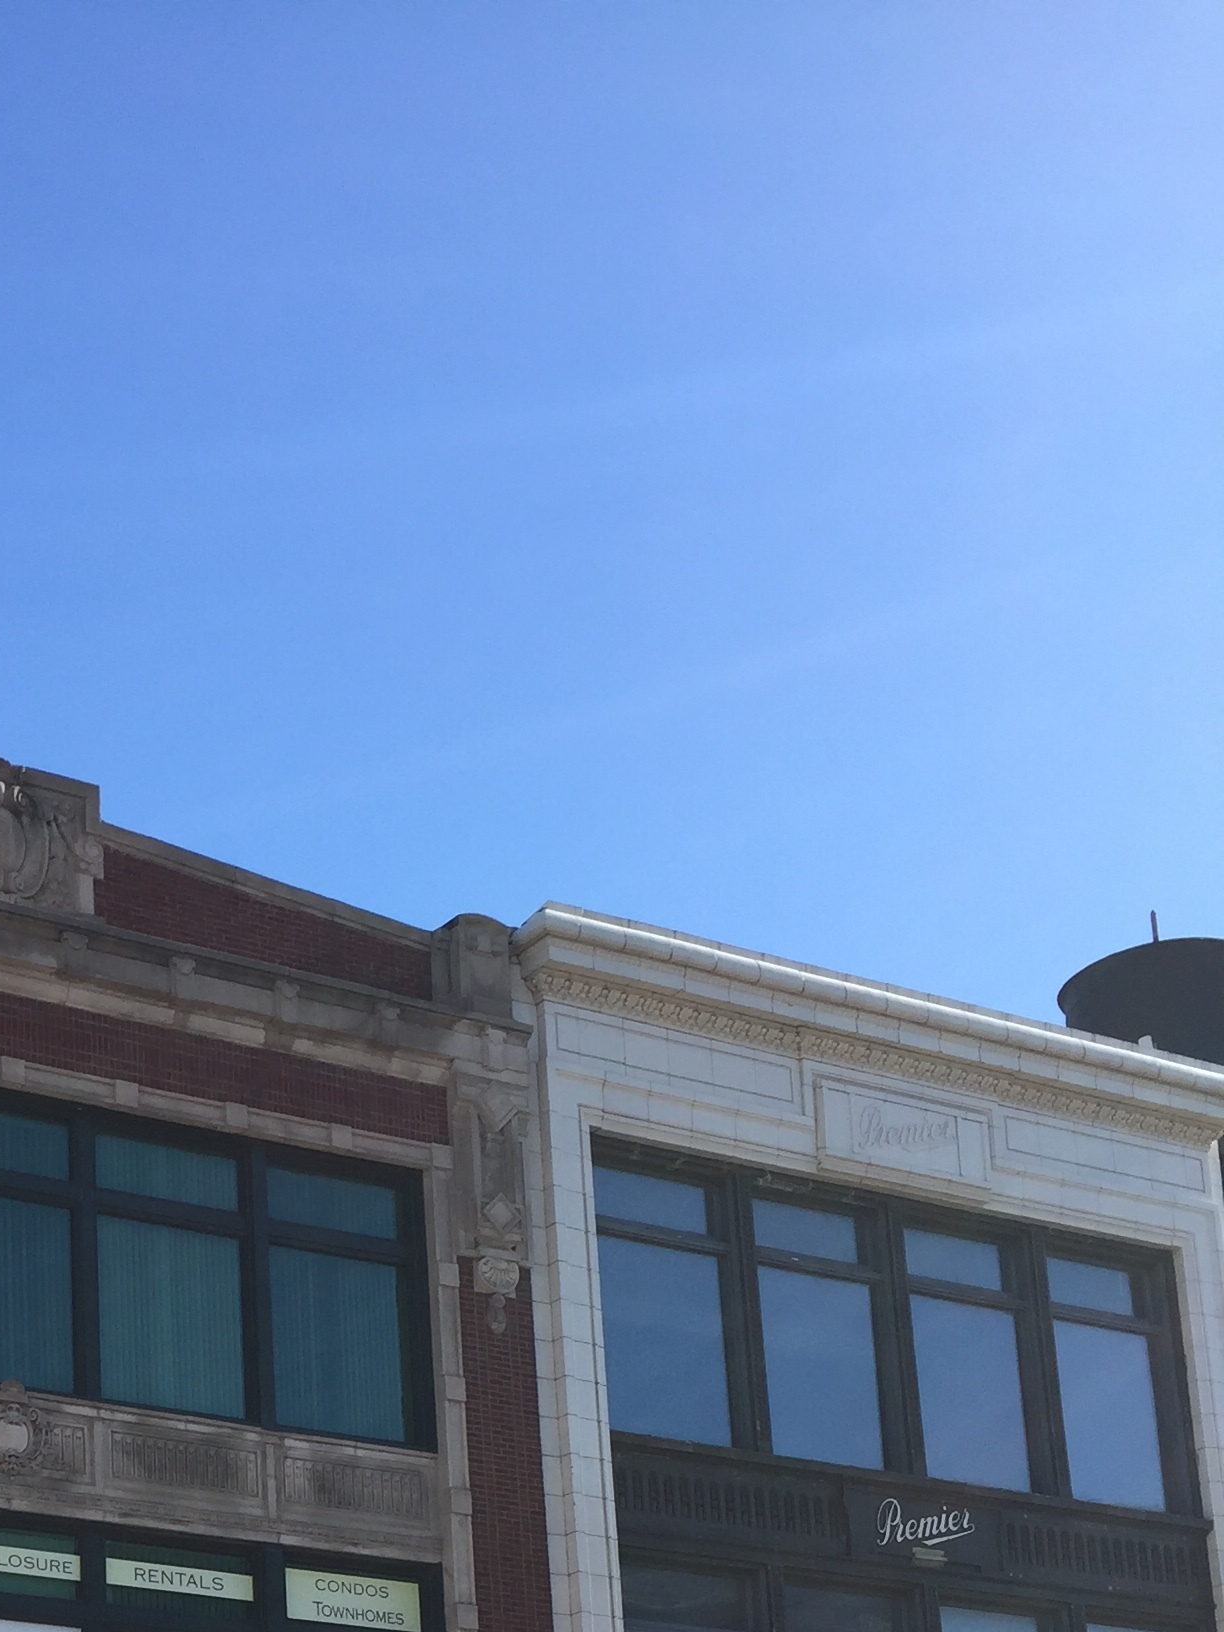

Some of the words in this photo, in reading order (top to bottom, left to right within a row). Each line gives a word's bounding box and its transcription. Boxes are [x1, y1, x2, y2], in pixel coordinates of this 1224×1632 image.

[877, 1498, 975, 1546] Premier
[134, 1567, 225, 1592] RENTALS
[315, 1578, 390, 1599] CONDOS
[312, 1601, 406, 1626] TOWNHOMES
